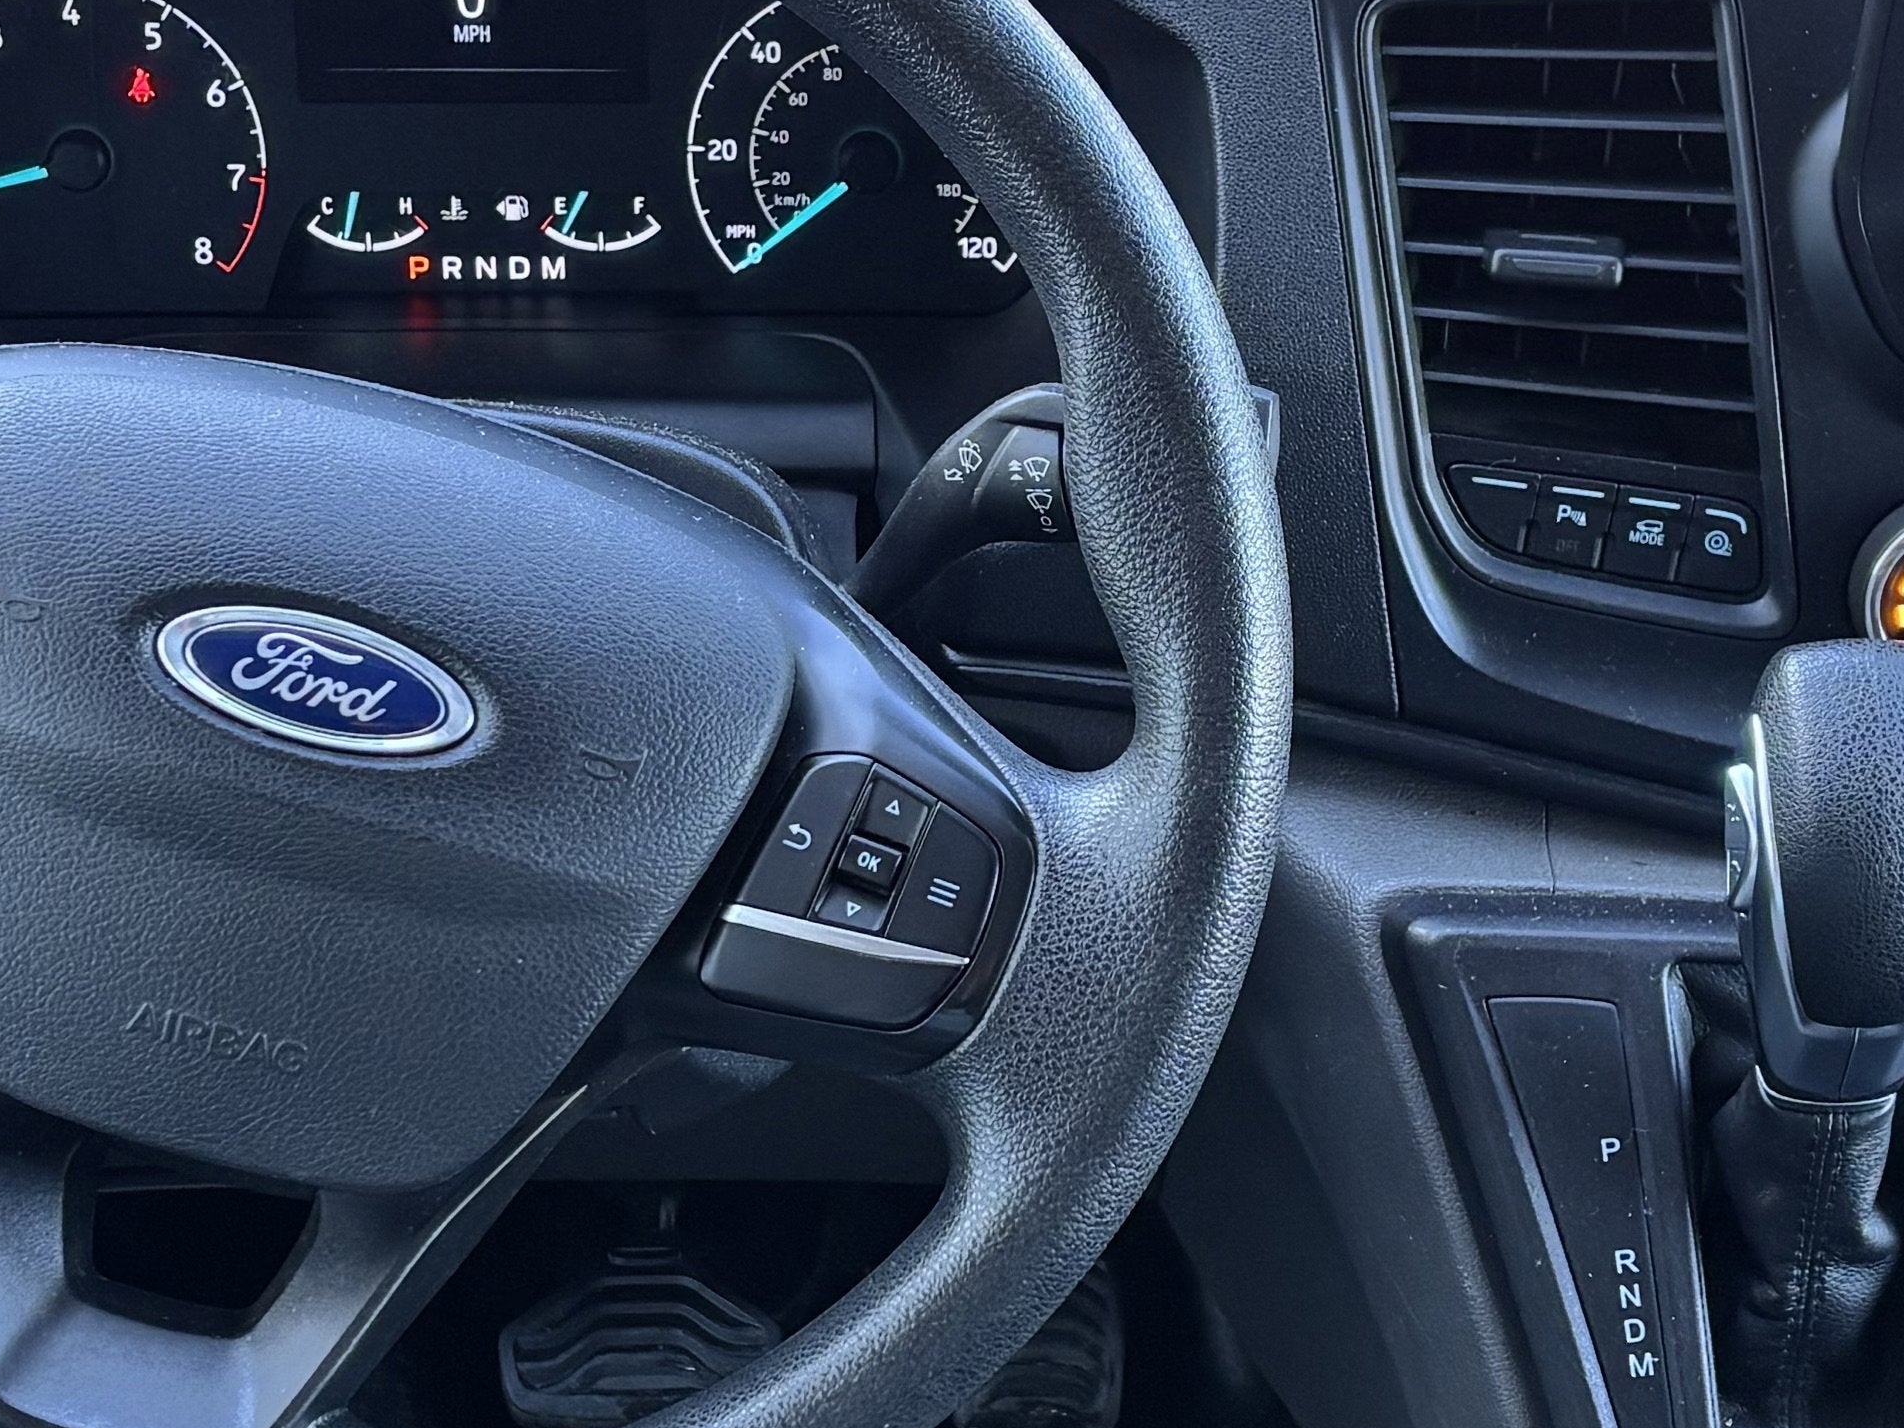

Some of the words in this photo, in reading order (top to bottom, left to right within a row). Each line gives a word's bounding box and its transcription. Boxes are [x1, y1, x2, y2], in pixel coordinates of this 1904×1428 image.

[143, 21, 163, 51] 5
[452, 23, 492, 44] MPH
[749, 41, 782, 64] 40
[822, 67, 843, 82] 80
[206, 78, 227, 108] 6
[788, 92, 808, 107] 60
[769, 130, 790, 145] 40
[707, 138, 738, 162] 20
[226, 163, 246, 192] 7
[771, 171, 791, 186] 20
[774, 193, 811, 207] km/h
[936, 183, 962, 198] 180
[320, 196, 334, 216] C
[398, 196, 413, 216] H
[553, 196, 568, 216] E
[632, 196, 645, 215] F
[725, 224, 756, 239] MPH
[194, 236, 214, 265] 8
[956, 236, 998, 260] 120
[408, 255, 430, 280] P
[441, 255, 463, 280] R
[475, 255, 498, 280] N
[508, 255, 531, 280] D
[540, 255, 567, 280] M
[1628, 529, 1666, 547] MODE
[231, 631, 397, 724] Ford
[856, 850, 883, 873] OK
[126, 1001, 310, 1074] AIRBAG
[1599, 1136, 1622, 1163] P
[1614, 1248, 1640, 1275] R
[1619, 1283, 1643, 1310] N
[1623, 1317, 1647, 1345] D
[1628, 1352, 1656, 1378] M
